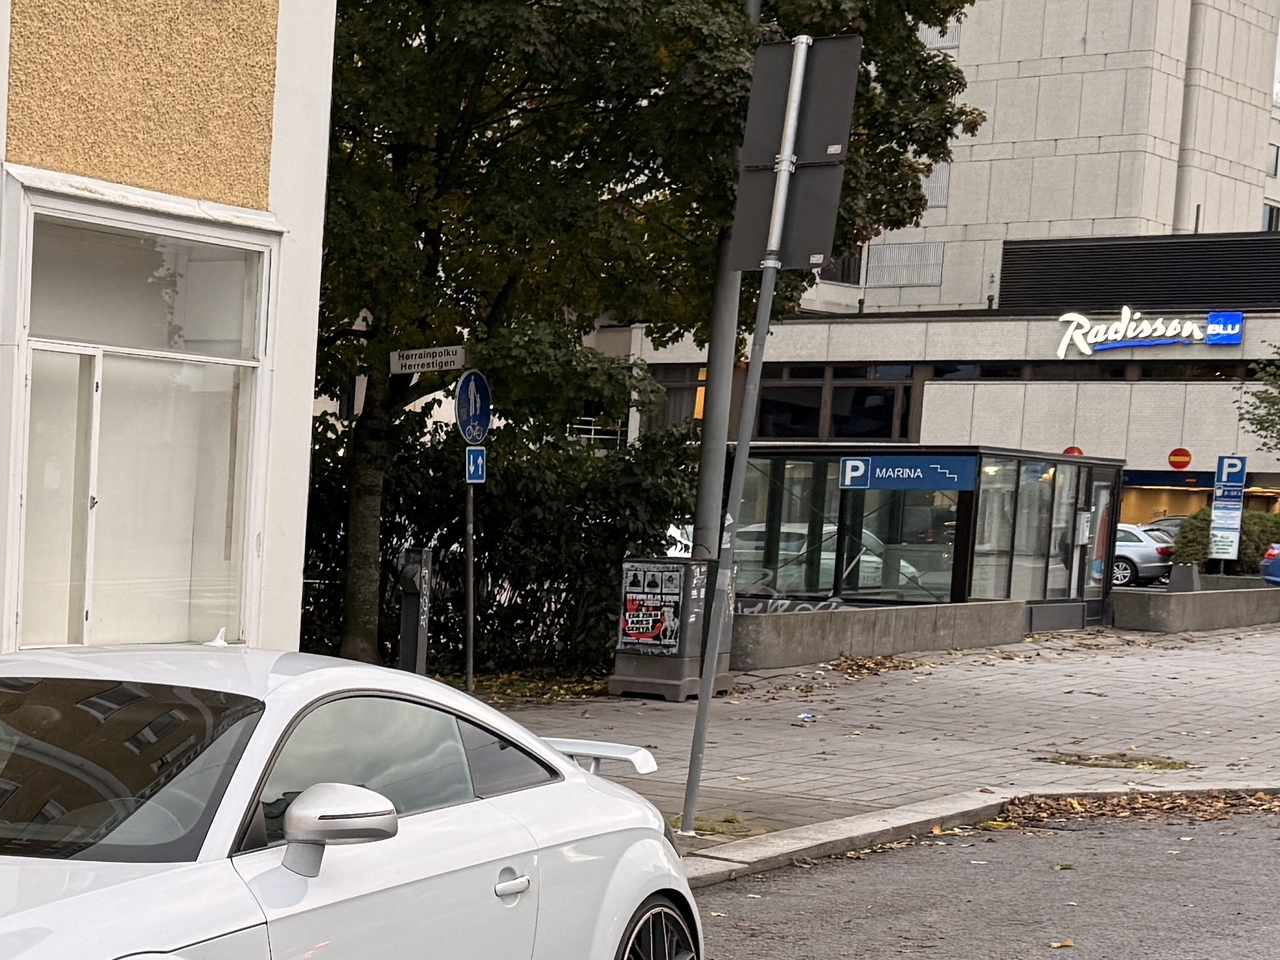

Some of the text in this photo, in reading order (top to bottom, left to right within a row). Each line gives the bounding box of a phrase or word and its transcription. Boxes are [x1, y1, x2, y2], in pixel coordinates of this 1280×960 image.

[1057, 305, 1240, 360] Radisson BLU
[398, 348, 458, 361] Herrainpolku
[400, 359, 456, 371] Herrestigen
[844, 460, 923, 486] P MARINA
[1221, 458, 1243, 482] P
